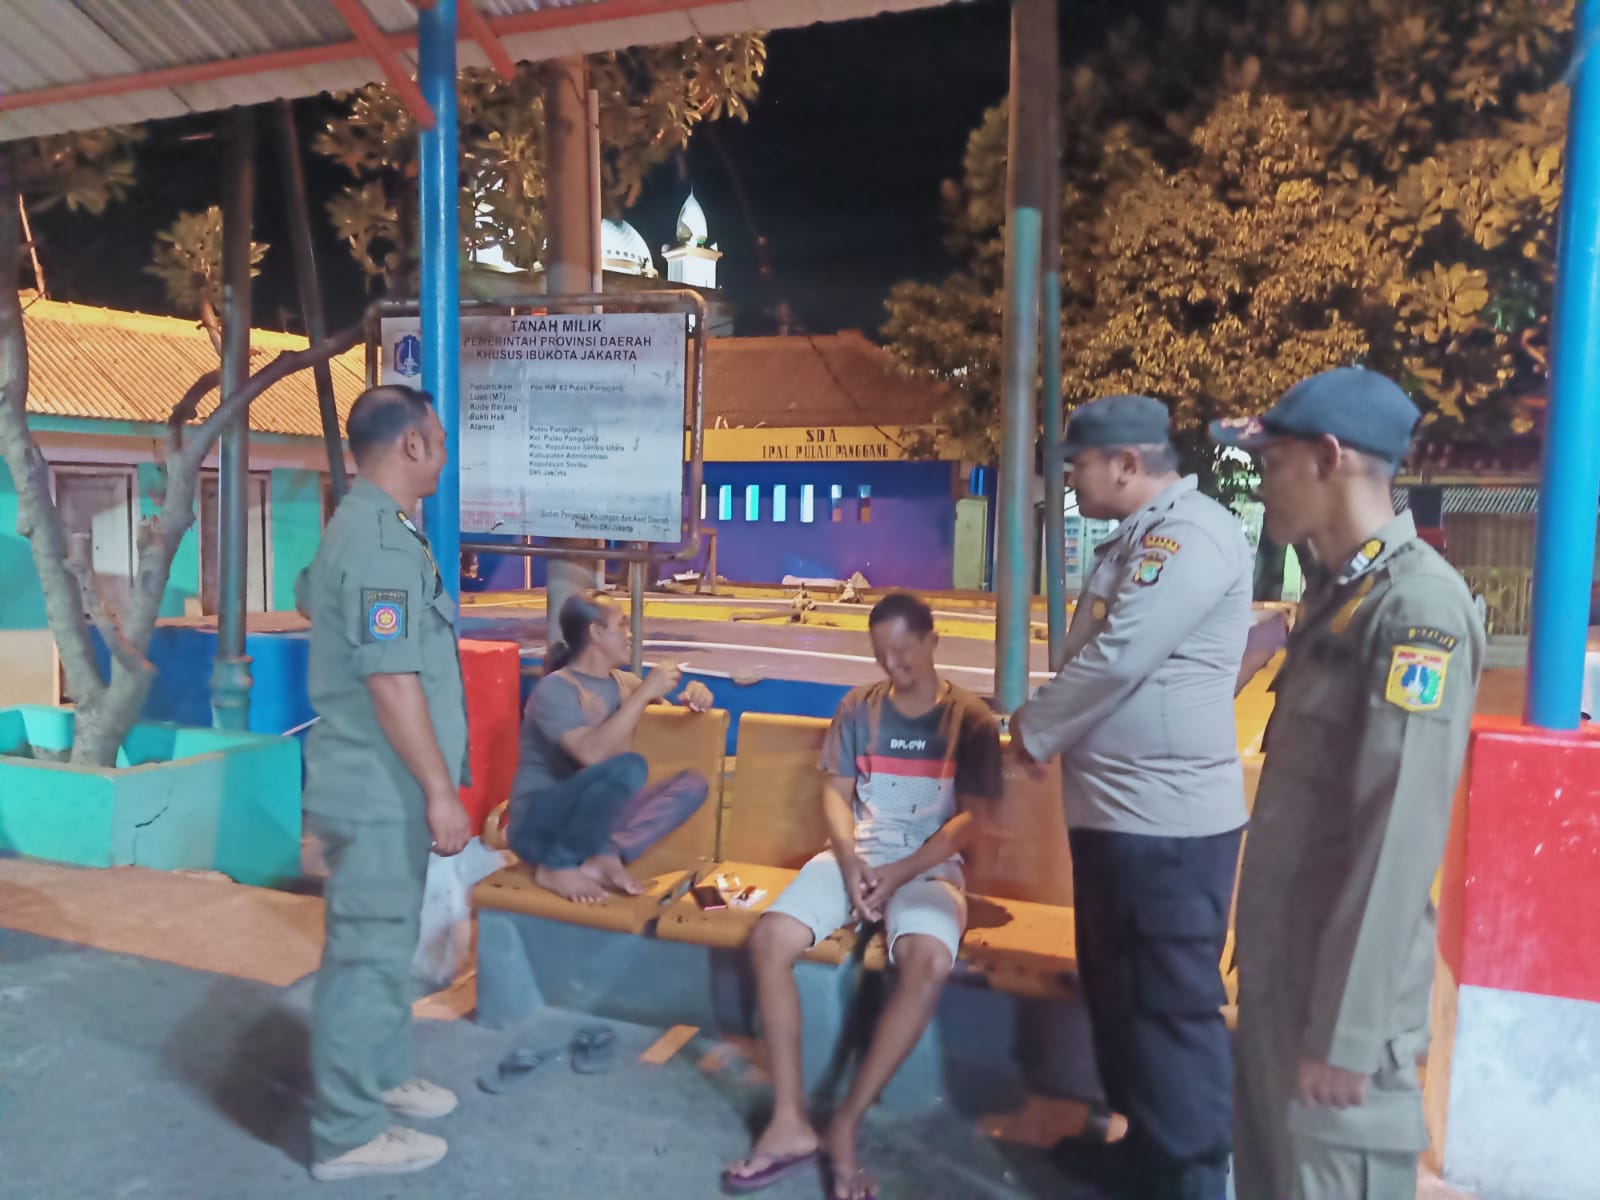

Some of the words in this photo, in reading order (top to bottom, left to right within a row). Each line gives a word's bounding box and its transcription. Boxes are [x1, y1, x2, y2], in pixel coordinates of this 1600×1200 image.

[511, 320, 558, 332] TANAH
[563, 320, 602, 332] MILIK
[463, 336, 537, 347] PEMERINTAH
[541, 336, 596, 346] PROVINSI
[600, 336, 651, 346] DAERAH
[476, 349, 523, 360] KHUSUS
[526, 350, 578, 360] IBUKOTA
[581, 350, 637, 360] JAKARTA
[806, 429, 837, 442] SDA
[796, 445, 832, 459] PULAU
[836, 444, 889, 458] PANGGANG
